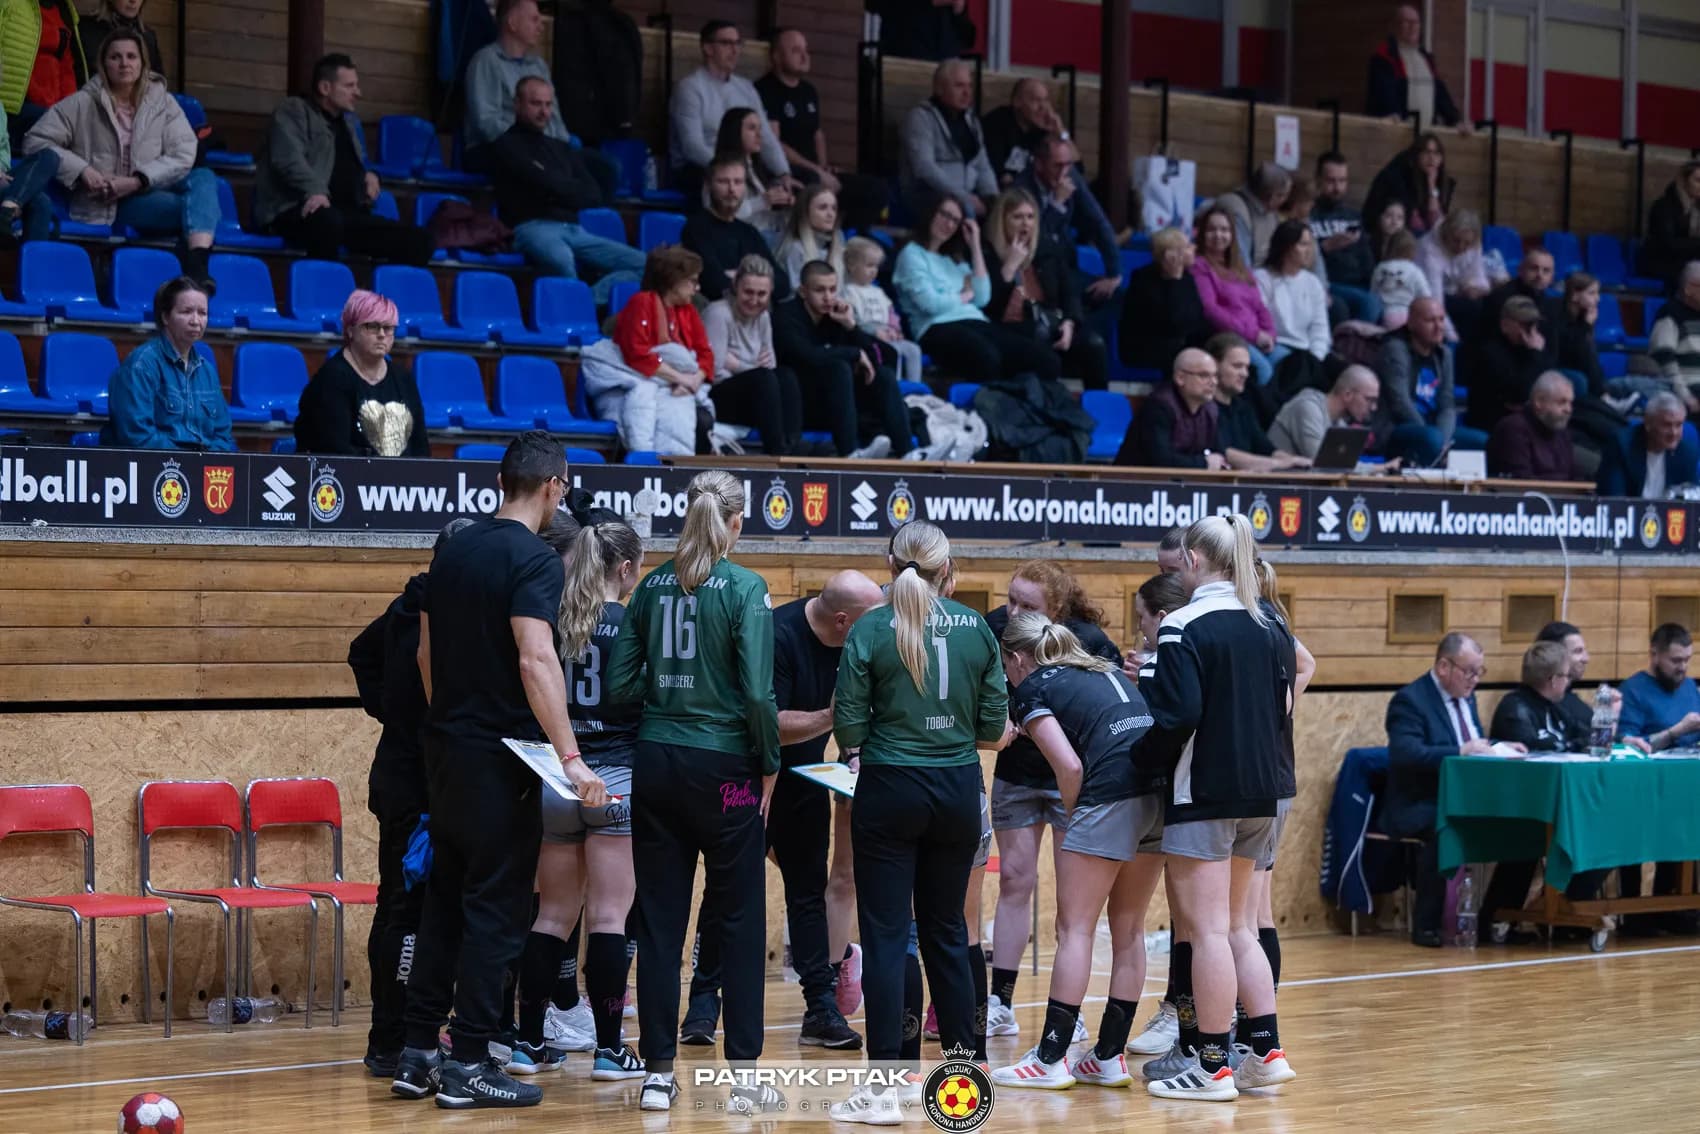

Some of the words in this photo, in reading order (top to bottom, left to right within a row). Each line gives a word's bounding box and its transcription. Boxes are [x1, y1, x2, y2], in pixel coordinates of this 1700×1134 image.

[207, 485, 228, 509] CK
[262, 512, 295, 521] SUZUKI
[805, 500, 823, 523] CK
[660, 595, 697, 659] 16
[932, 637, 949, 700] 1
